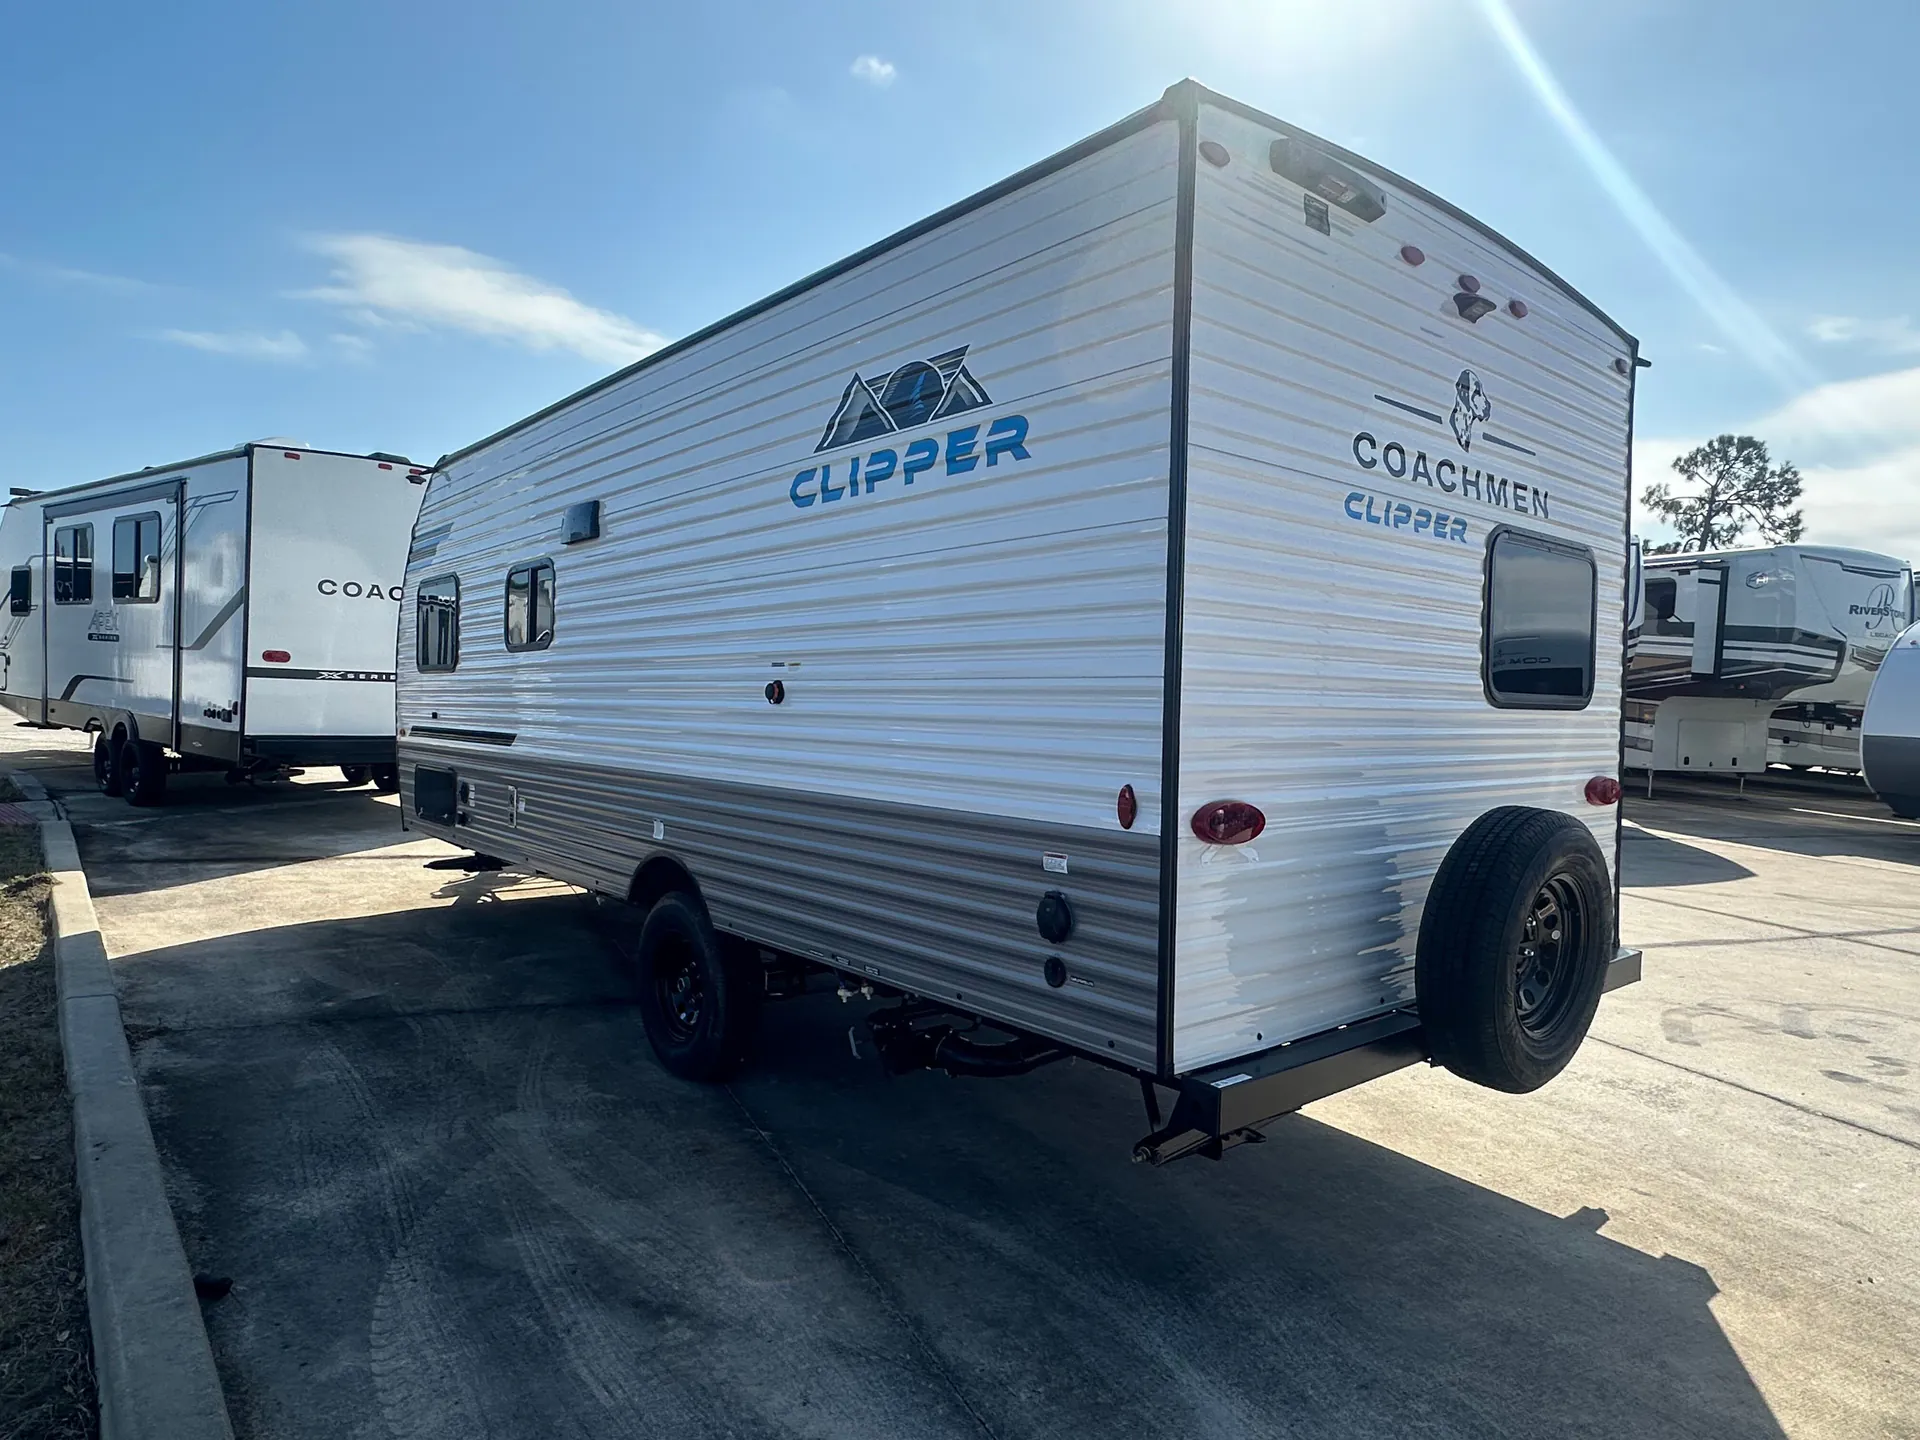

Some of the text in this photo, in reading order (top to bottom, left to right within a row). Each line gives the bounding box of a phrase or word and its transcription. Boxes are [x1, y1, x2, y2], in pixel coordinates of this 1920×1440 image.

[789, 414, 1032, 508] CLIPPER
[1353, 432, 1549, 519] COACHMEN
[1344, 492, 1468, 544] CLIPPER
